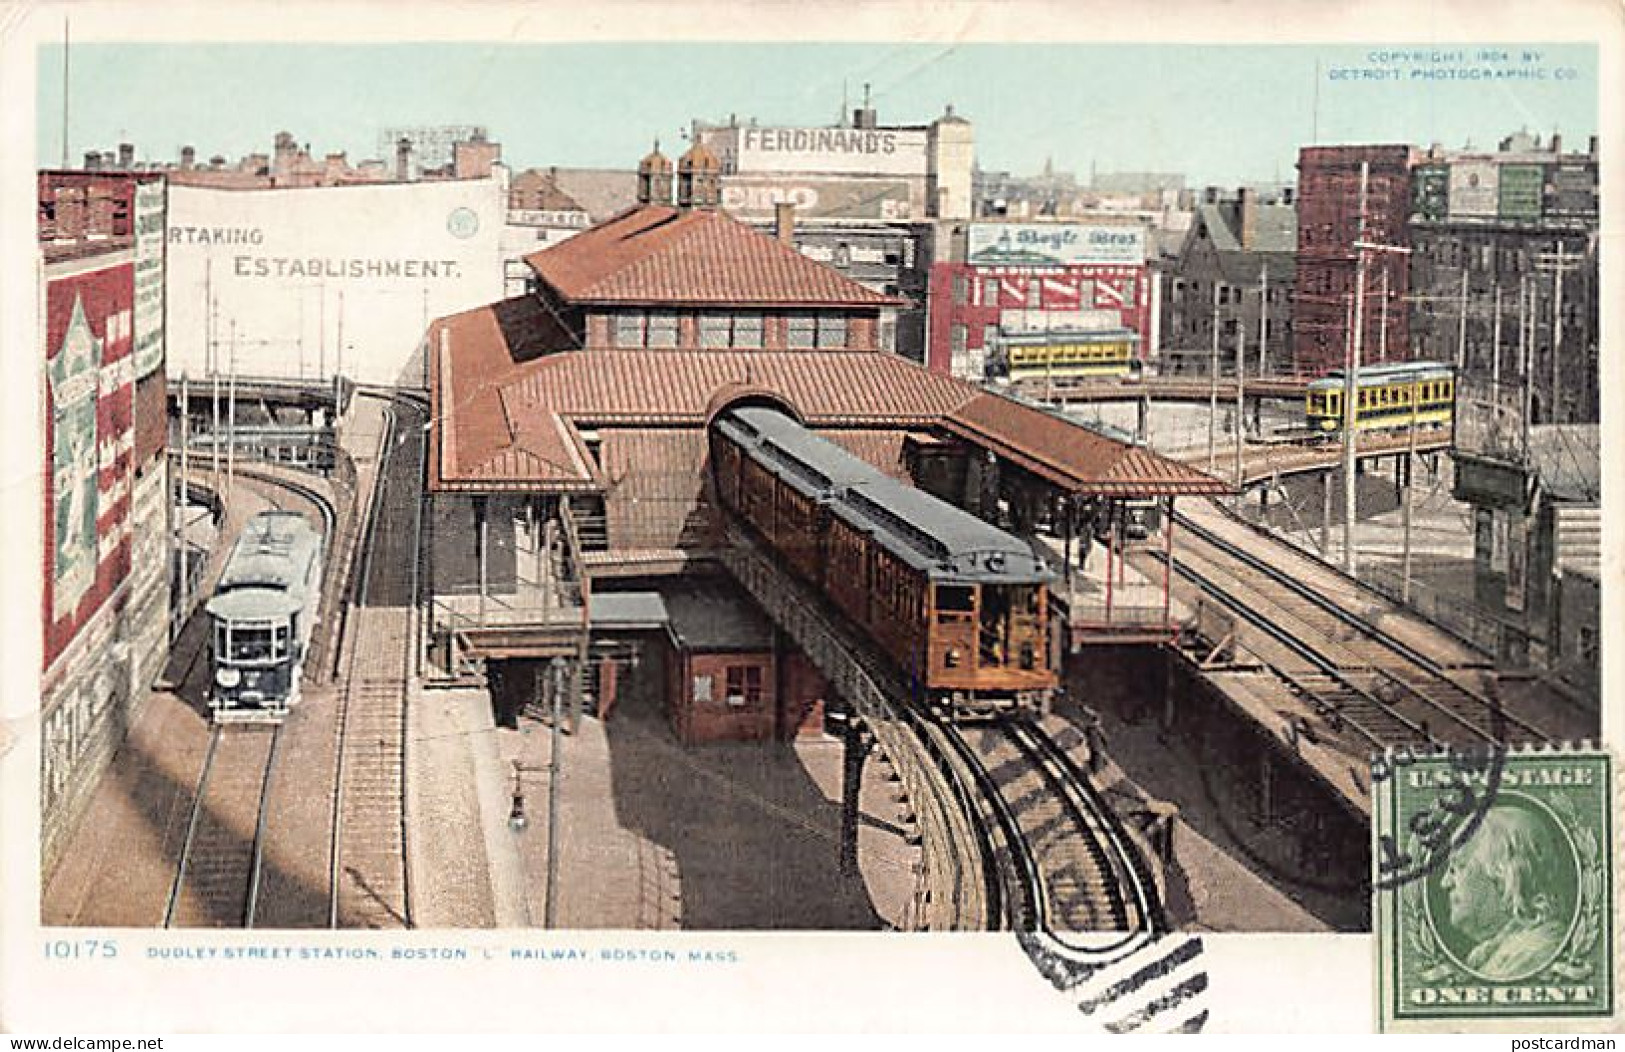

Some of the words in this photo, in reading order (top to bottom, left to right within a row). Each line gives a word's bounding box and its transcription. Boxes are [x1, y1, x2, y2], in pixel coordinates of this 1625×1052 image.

[744, 130, 897, 155] FERDINAND'S
[234, 255, 462, 279] ESTABLISHMENT.
[1411, 987, 1489, 1004] ONE
[1491, 986, 1595, 1004] CENT
